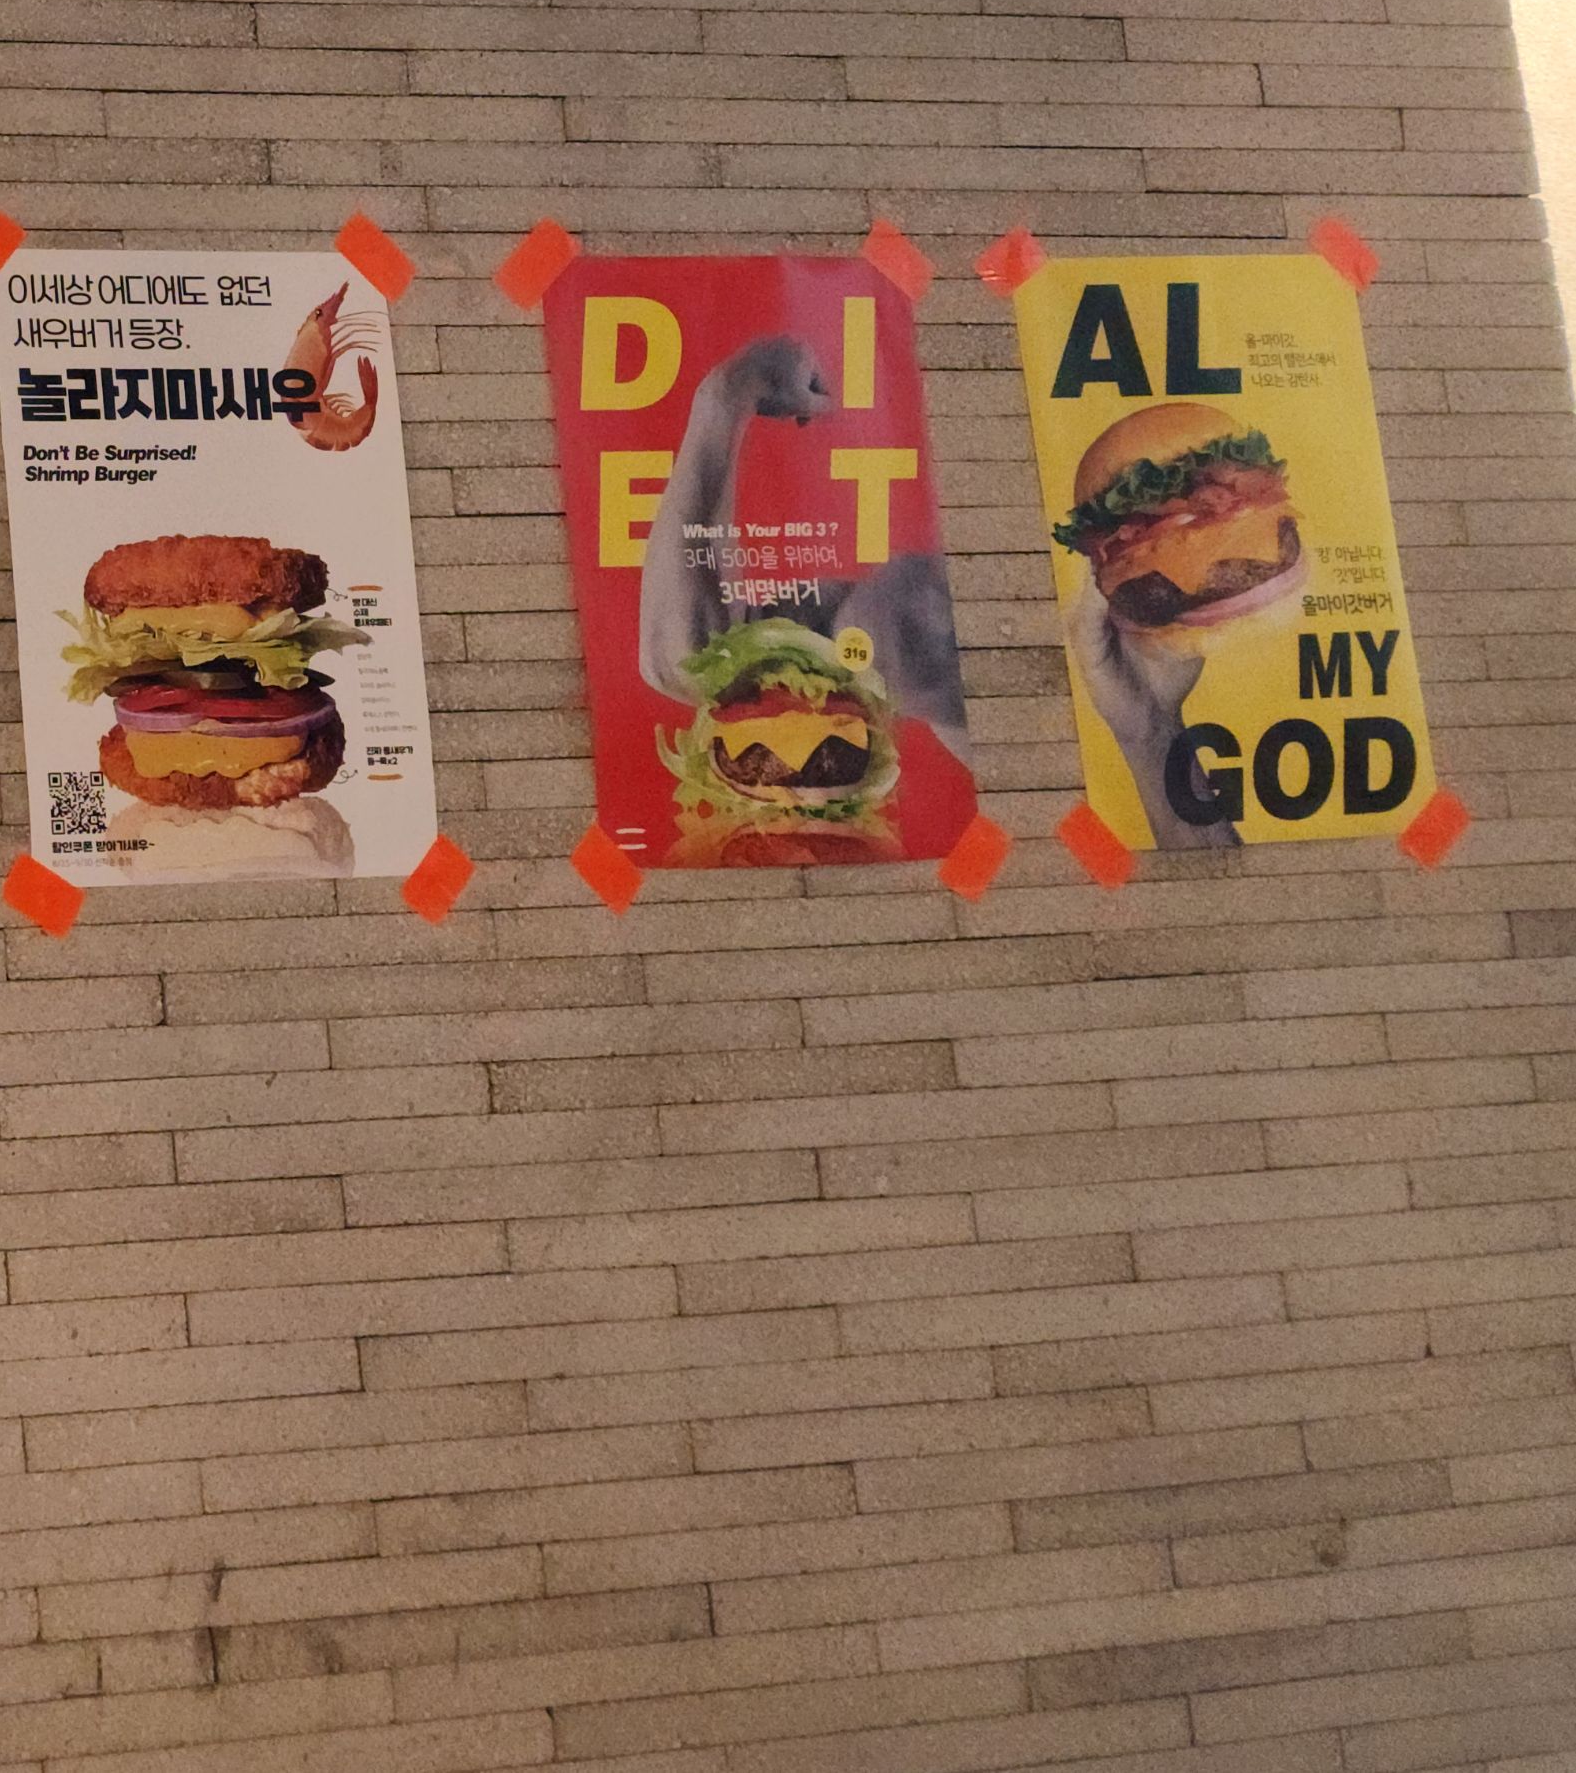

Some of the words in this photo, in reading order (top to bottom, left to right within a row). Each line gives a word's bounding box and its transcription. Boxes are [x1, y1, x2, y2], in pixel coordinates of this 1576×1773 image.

[7, 273, 94, 306] 이세상
[98, 275, 209, 307] 어디에도
[217, 275, 272, 308] 없던
[13, 317, 125, 350] 새우버거
[129, 318, 191, 351] 등장.
[1050, 282, 1243, 399] AL
[1248, 353, 1283, 370] 최고의
[1251, 372, 1285, 388] 나오는
[17, 367, 321, 422] 놀라지마새우
[23, 444, 70, 462] Don't
[75, 445, 100, 461] Be
[104, 444, 197, 465] Surprised!
[25, 466, 90, 485] Shrimp
[94, 466, 158, 486] Burger
[683, 523, 724, 539] What
[745, 523, 781, 538] Your
[784, 522, 813, 538] BIG
[684, 545, 716, 570] 3대
[721, 545, 779, 570] 500을
[783, 545, 843, 570] 위하여,
[719, 578, 821, 606] 3대몇버거
[1302, 592, 1394, 617] 올마이갓버거
[843, 647, 867, 661] 31g
[1298, 630, 1400, 700] MY
[1164, 716, 1417, 826] GOD
